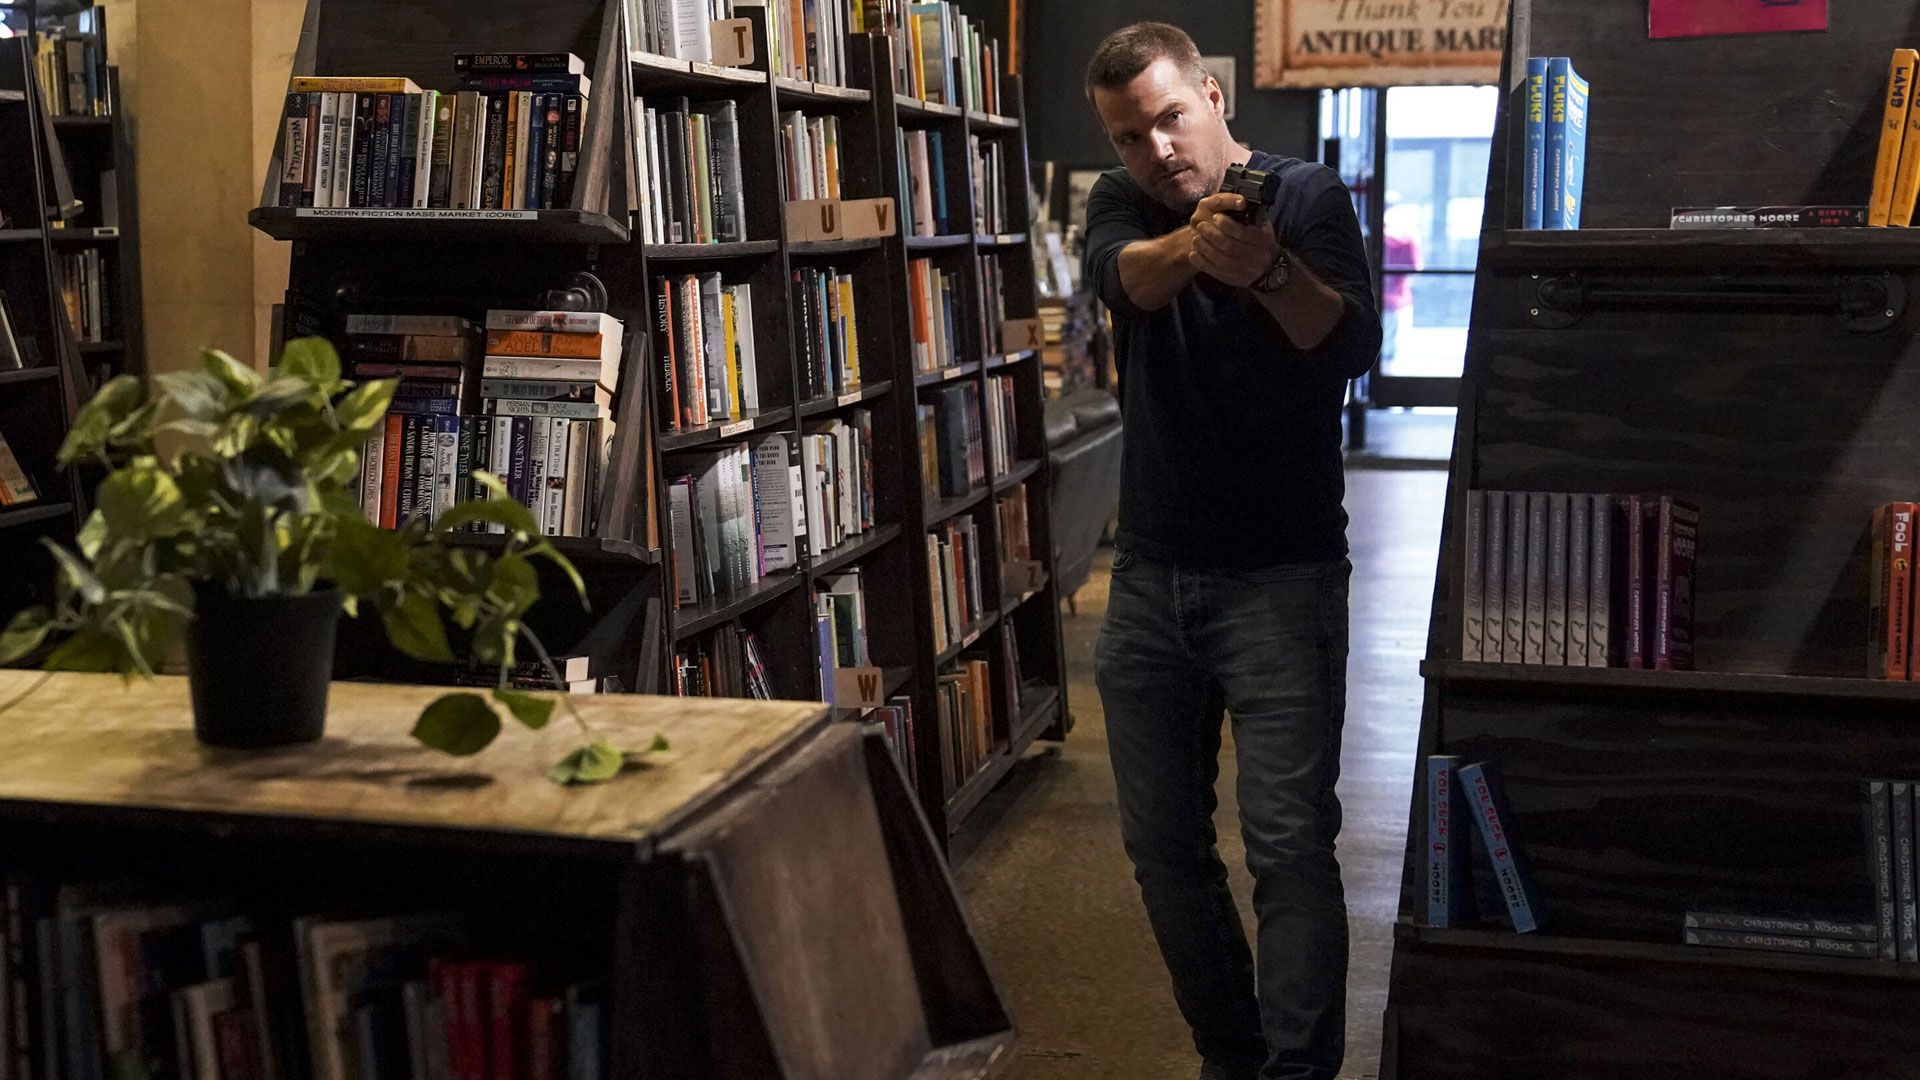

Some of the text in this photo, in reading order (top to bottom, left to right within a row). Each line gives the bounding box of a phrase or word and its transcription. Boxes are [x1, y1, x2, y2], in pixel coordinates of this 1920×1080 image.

[1337, 0, 1420, 20] Thank
[733, 26, 746, 58] T
[1298, 29, 1424, 58] ANTIQUE
[475, 56, 509, 65] EMPEROR
[1530, 75, 1543, 123] FLUKE
[1552, 76, 1565, 123] FLUKE
[1891, 66, 1908, 108] LAMB
[287, 120, 302, 181] WELLVILLE
[323, 132, 332, 146] GREAT
[313, 209, 359, 217] MODERN
[485, 211, 523, 219] (CORE)
[820, 204, 835, 234] U
[875, 203, 888, 231] V
[1678, 214, 1800, 223] CHRISTOPHER MOORE
[657, 294, 668, 333] HISTORY
[504, 342, 537, 352] AUEL
[1027, 323, 1038, 345] X
[407, 431, 415, 455] SANDRA
[420, 426, 429, 457] LAMBDIN
[428, 432, 436, 457] DEWEY
[459, 430, 470, 475] ANNE TYLER
[514, 433, 525, 479] ANNE TYLER
[404, 455, 414, 480] BROWN
[529, 459, 537, 490] Method
[417, 476, 425, 518] COMMISSION
[423, 476, 433, 515] THE KING'S
[1895, 512, 1910, 552] FOOL
[857, 673, 877, 702] W
[1438, 770, 1448, 837] YOU SUCK
[1475, 776, 1502, 842] YOU SUCK
[1432, 862, 1440, 904] MOORE
[1501, 870, 1520, 909] MOORE
[1878, 836, 1892, 938] CHRISTOPHER MOORE
[1900, 837, 1913, 941] CHRISTOPHER MOORE
[1743, 918, 1809, 931] CHRISTOPHER
[1813, 920, 1854, 935] MOORE
[1744, 935, 1810, 948] CHRISTOPHER
[1815, 939, 1855, 952] MOORE
